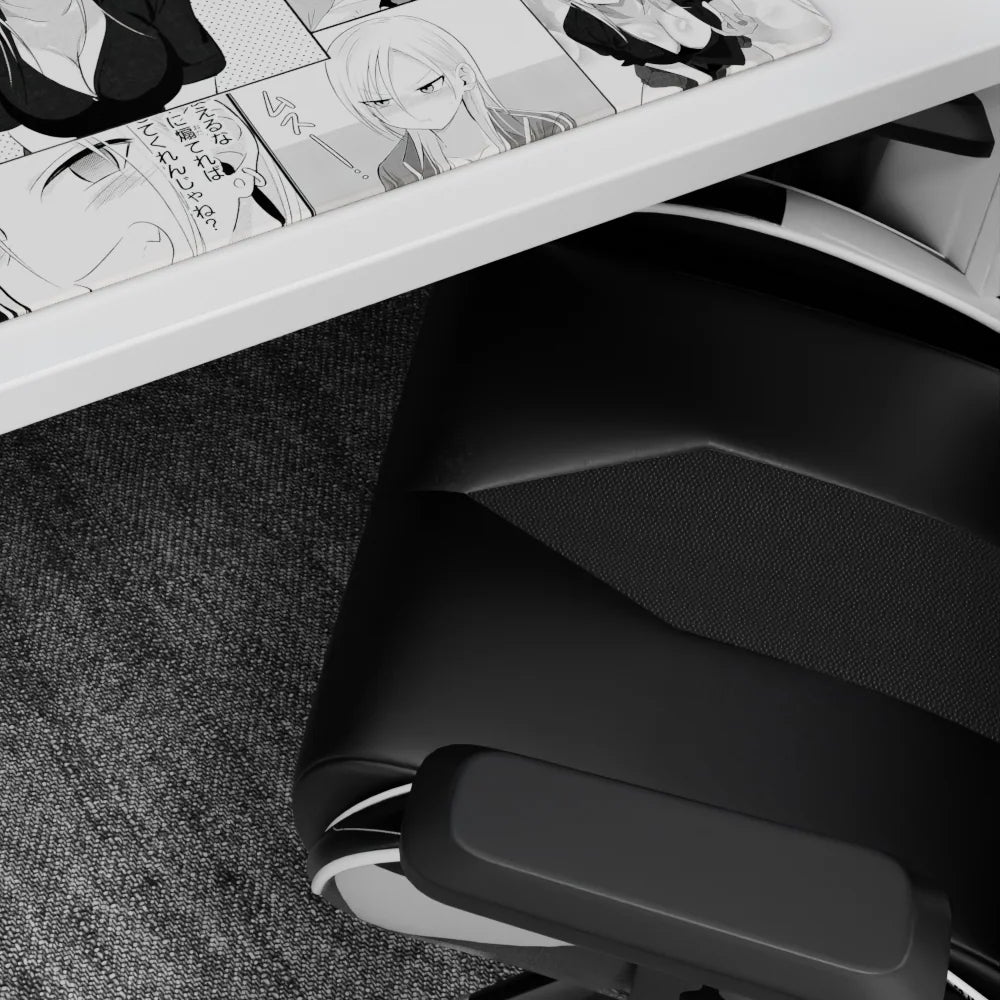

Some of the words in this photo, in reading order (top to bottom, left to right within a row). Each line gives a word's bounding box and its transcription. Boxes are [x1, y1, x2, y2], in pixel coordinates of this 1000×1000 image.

[137, 119, 218, 231] てくれんじゃね?
[166, 108, 224, 182] に煽てれば
